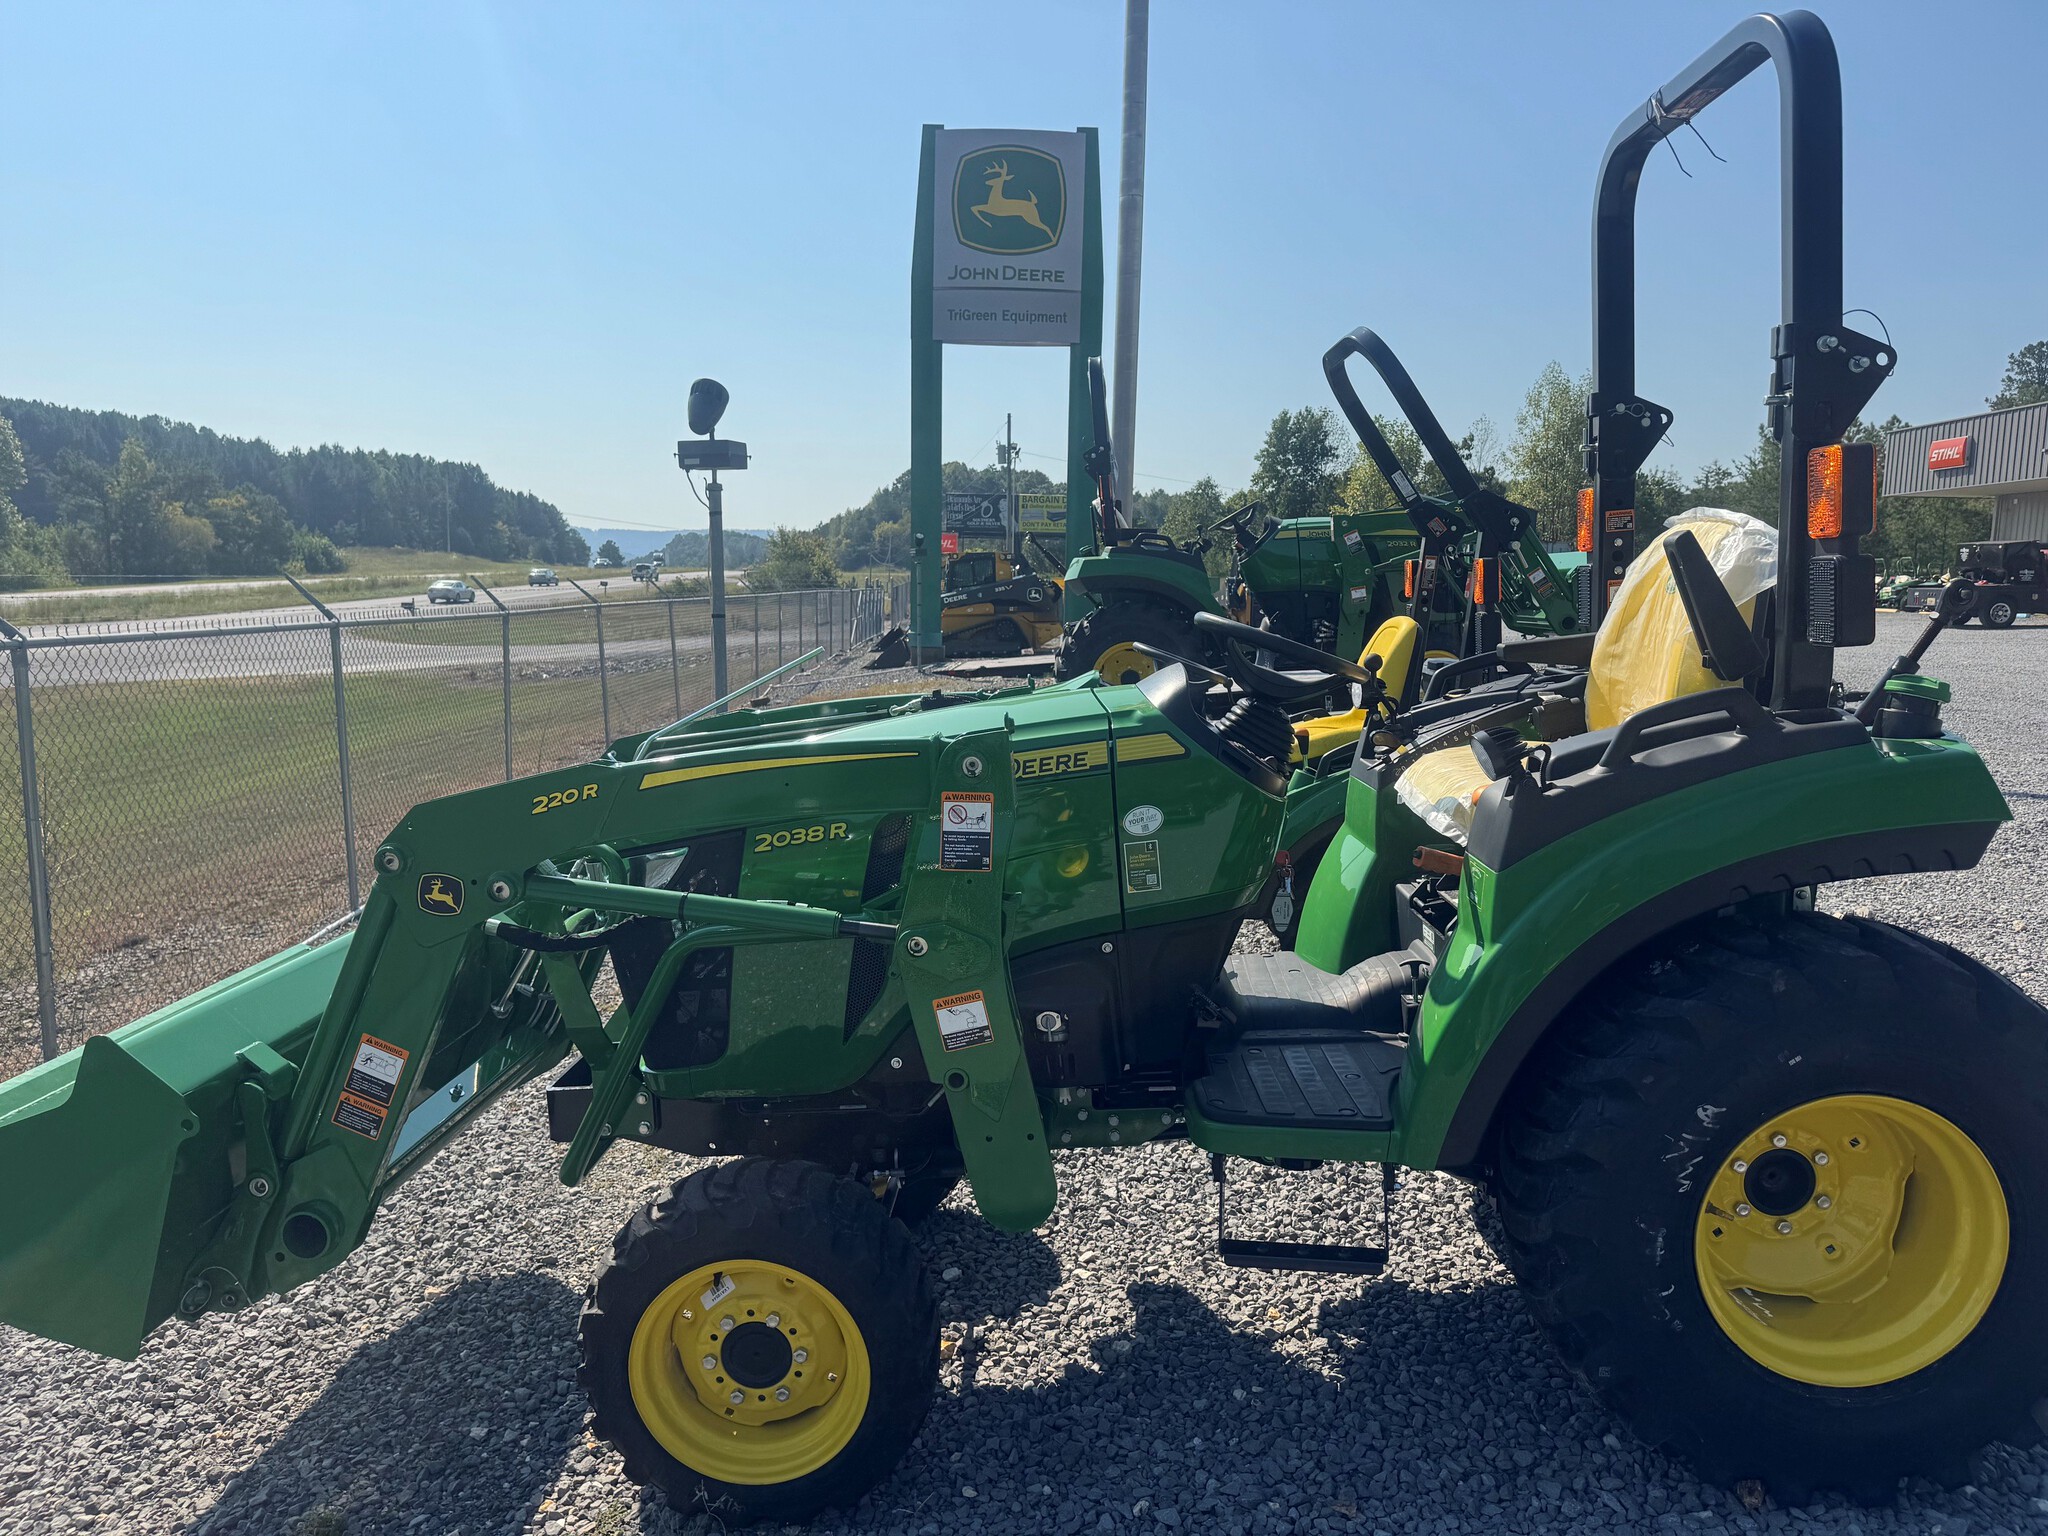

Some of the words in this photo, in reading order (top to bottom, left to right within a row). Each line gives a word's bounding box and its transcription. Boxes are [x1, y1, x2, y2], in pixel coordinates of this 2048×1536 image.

[948, 265, 998, 280] JOHN
[1002, 266, 1065, 282] DEERE
[947, 309, 997, 322] TriGreen
[1002, 310, 1068, 325] Equipment
[1930, 446, 1960, 462] STIHL
[1022, 496, 1060, 504] BARGAIN
[943, 594, 968, 604] DEERE
[532, 788, 579, 815] 220
[582, 783, 599, 799] R
[1128, 817, 1144, 826] YOUR
[1145, 813, 1157, 822] WAY
[1132, 810, 1144, 818] RUN
[754, 824, 824, 853] 2038
[829, 822, 848, 839] R
[942, 992, 981, 1006] WARNING
[373, 1039, 403, 1057] WARNING
[353, 1099, 382, 1115] WARNING
